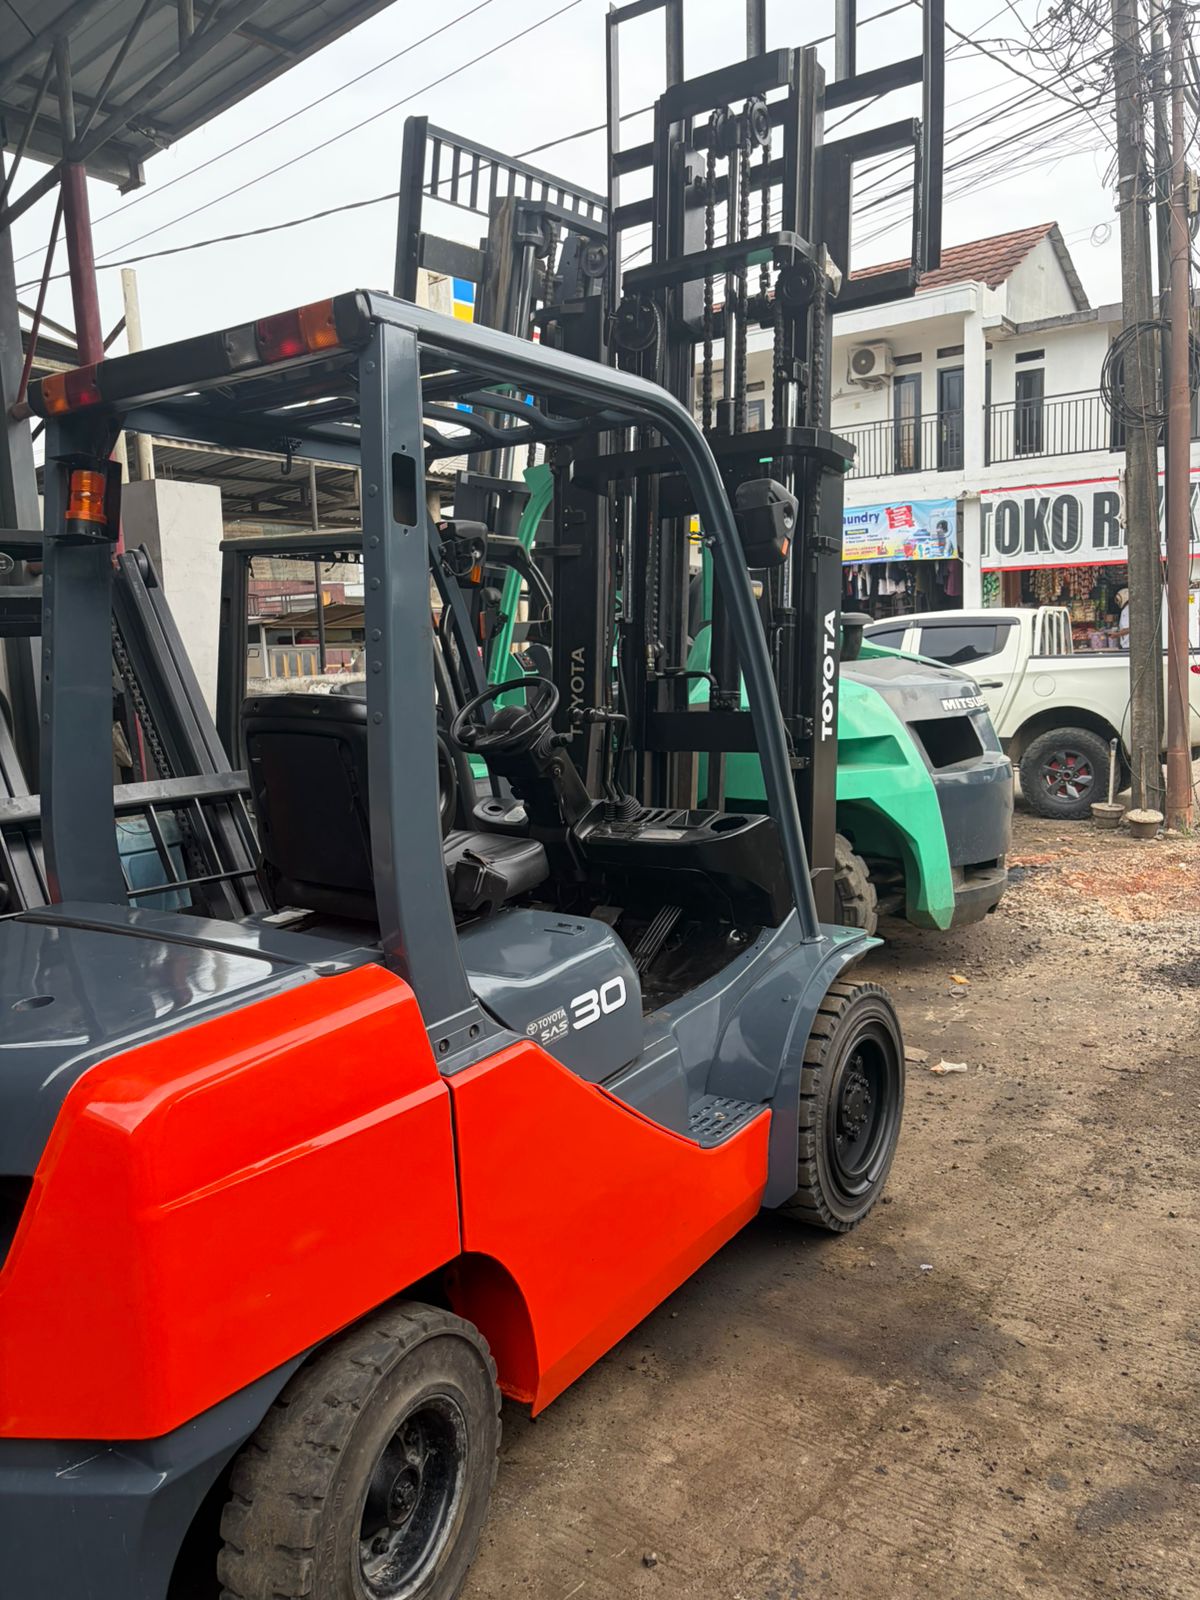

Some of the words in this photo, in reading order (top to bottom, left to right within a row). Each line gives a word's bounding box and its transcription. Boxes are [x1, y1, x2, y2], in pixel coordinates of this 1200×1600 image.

[570, 647, 585, 735] TYOTA
[821, 610, 836, 742] TOYOTA
[537, 1008, 567, 1029] TOYOTA
[570, 975, 627, 1030] 30
[541, 1019, 569, 1042] SAS
